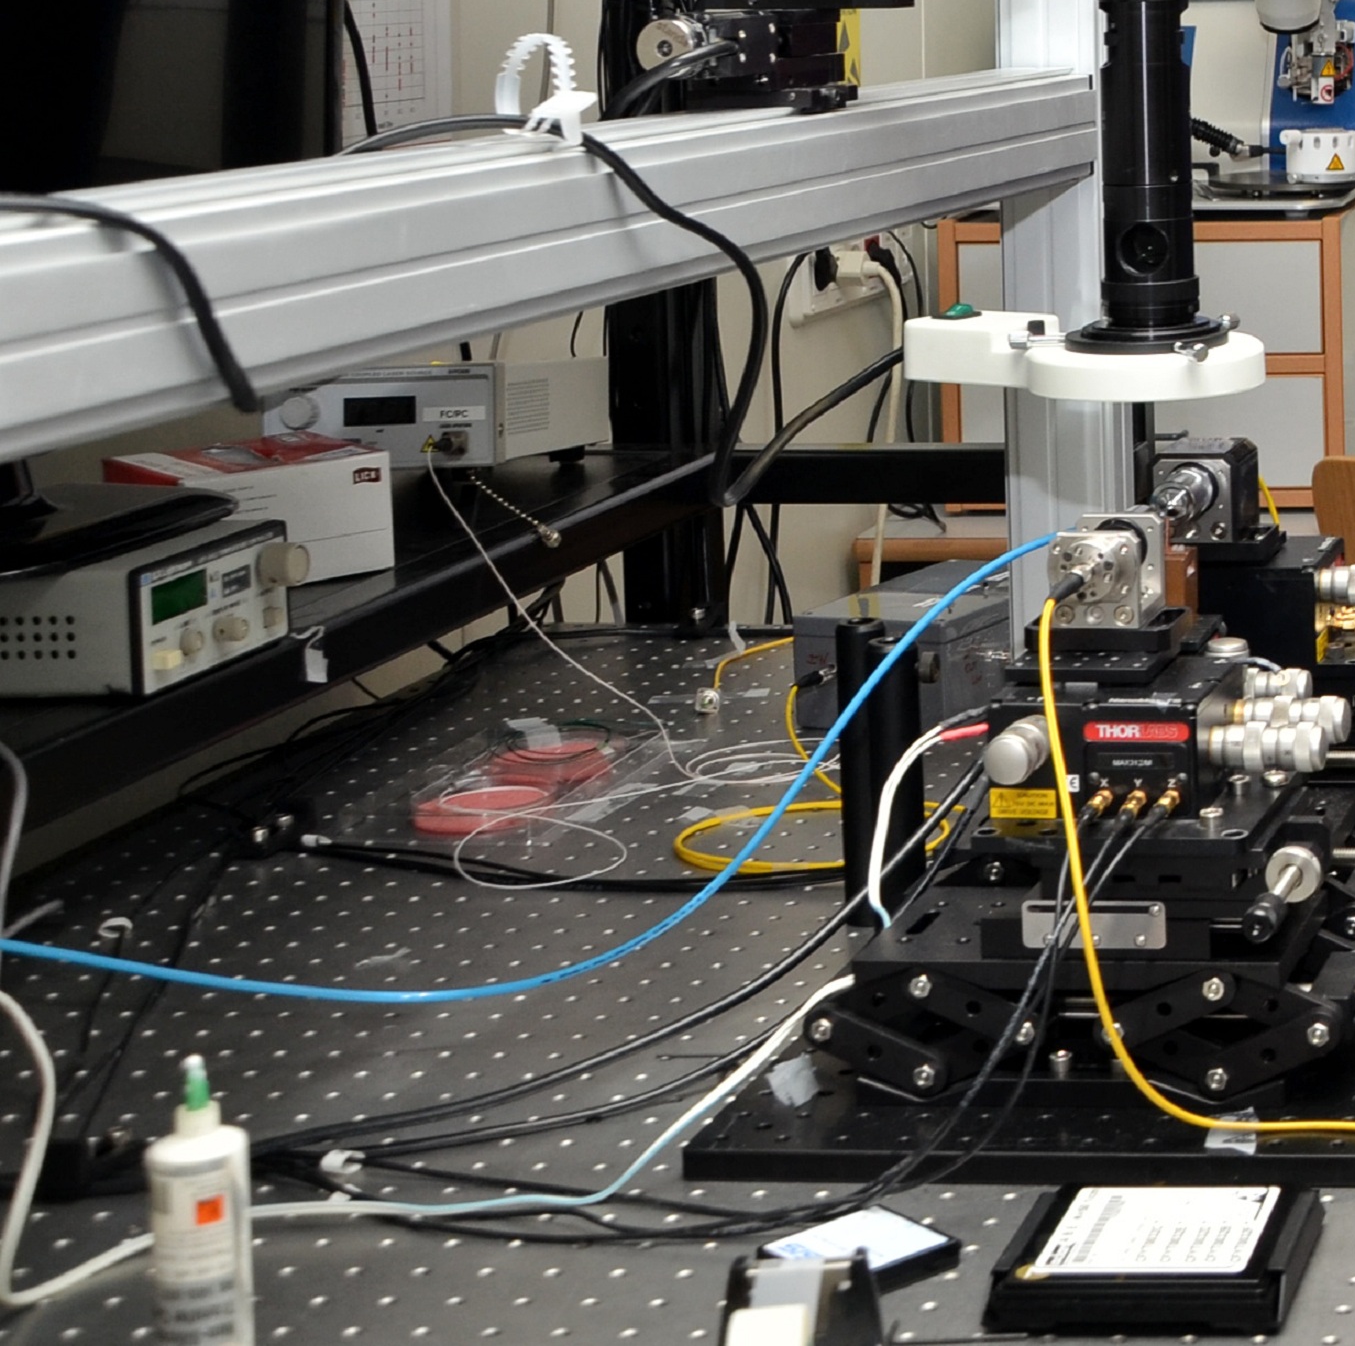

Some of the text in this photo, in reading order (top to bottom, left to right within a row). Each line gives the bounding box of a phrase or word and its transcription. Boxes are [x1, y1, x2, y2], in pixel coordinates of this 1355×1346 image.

[439, 410, 469, 419] FC/PC
[1095, 725, 1179, 739] THORLABS
[1100, 779, 1176, 787] X Y Z
